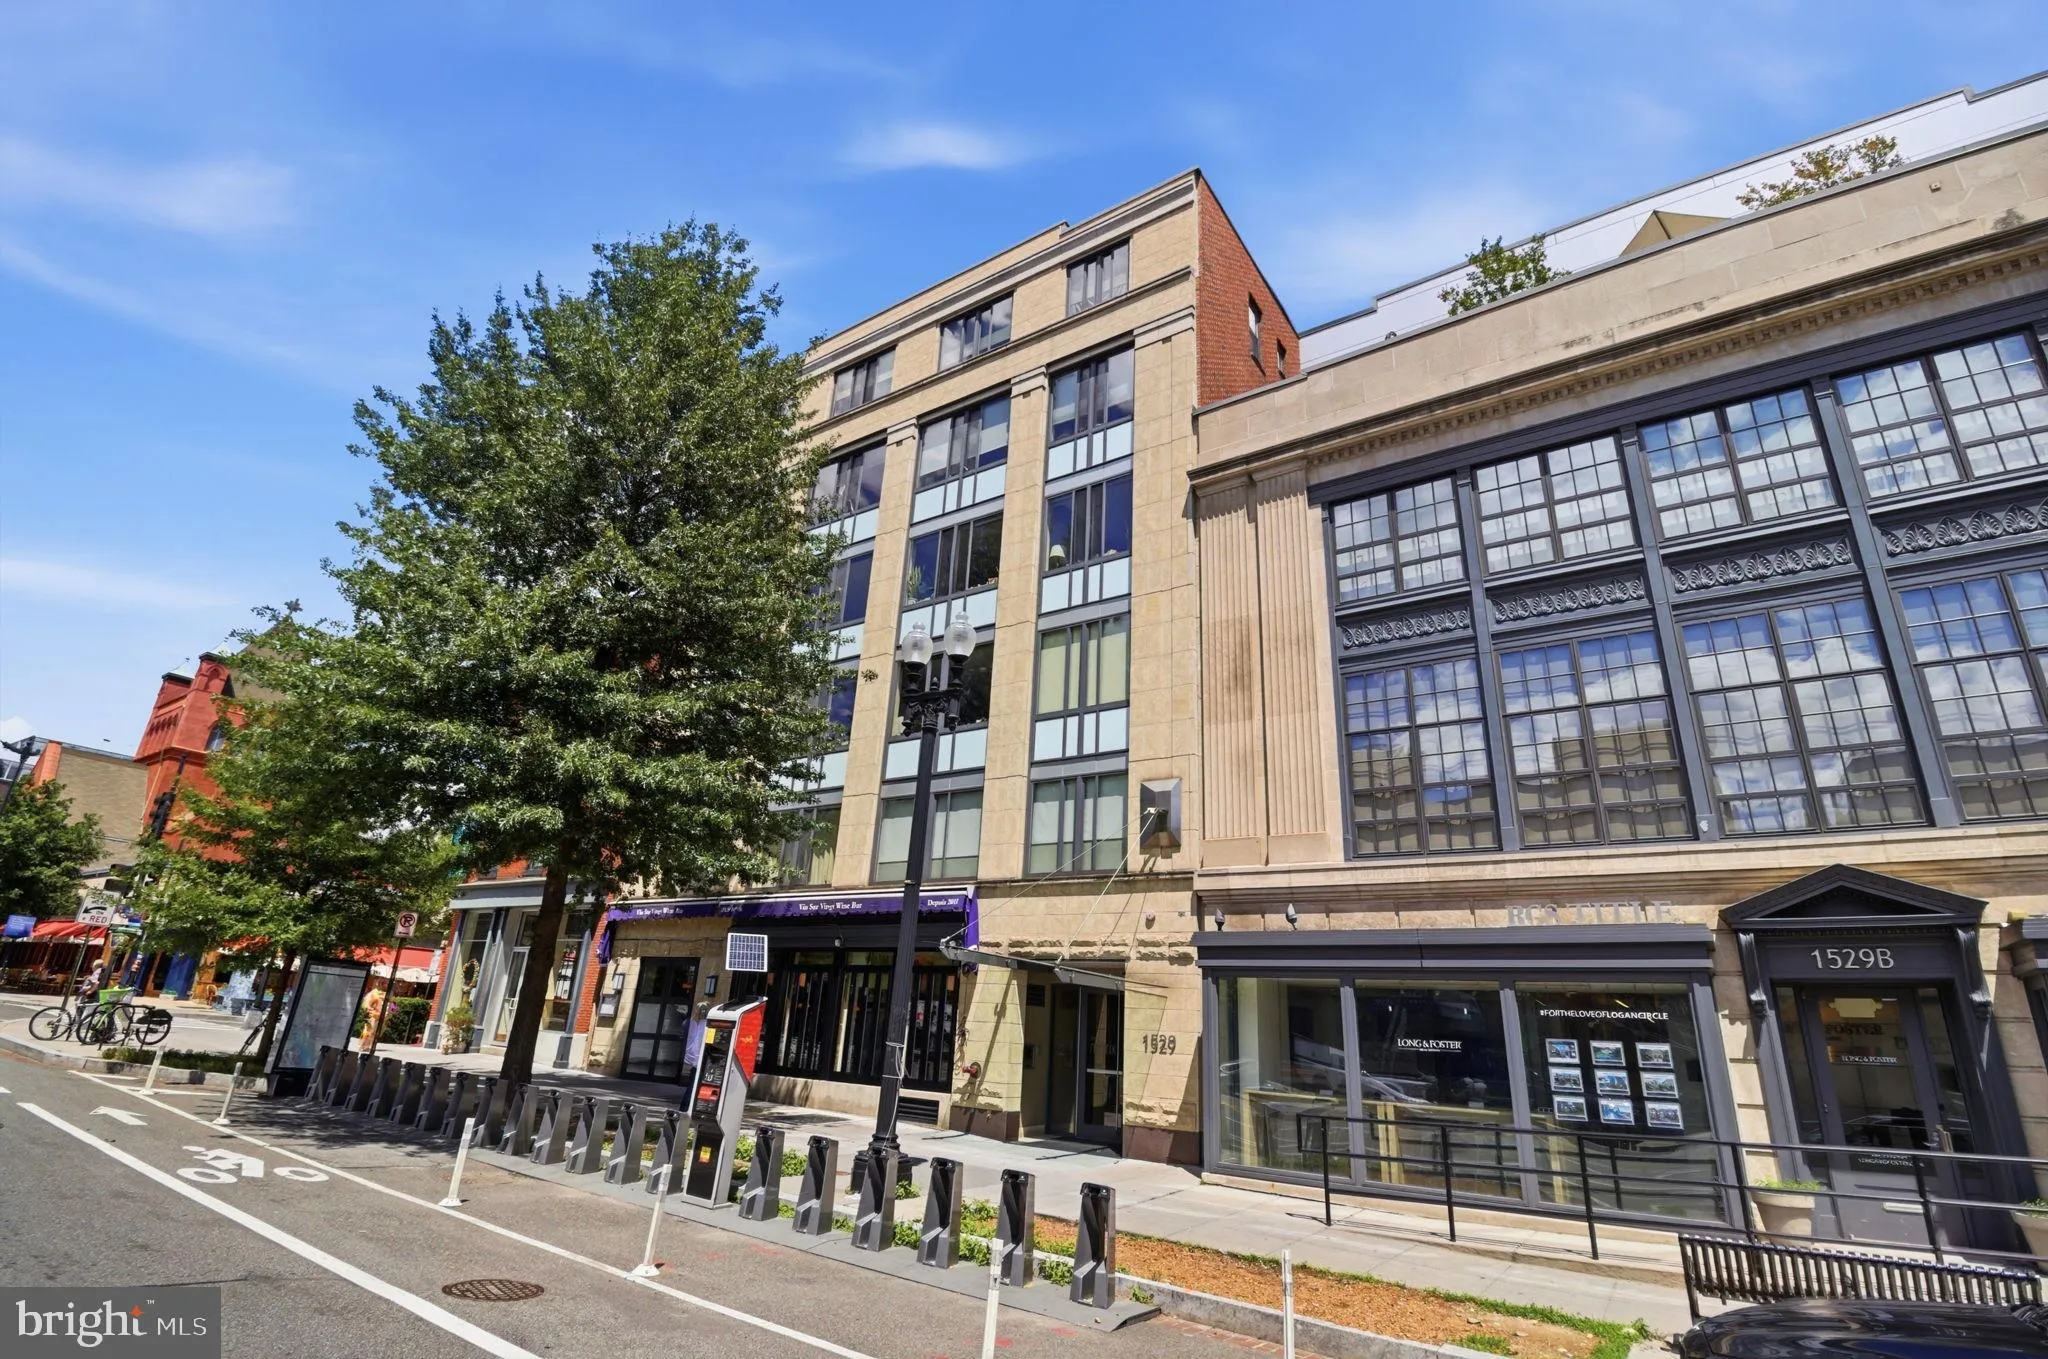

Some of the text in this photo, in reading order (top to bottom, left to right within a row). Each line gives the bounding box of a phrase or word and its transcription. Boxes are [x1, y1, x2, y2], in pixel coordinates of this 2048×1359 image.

[89, 915, 108, 924] RED
[1811, 948, 1894, 969] 1529B
[1142, 1034, 1176, 1055] 1529
[1397, 1038, 1462, 1049] LONG & FOSTER
